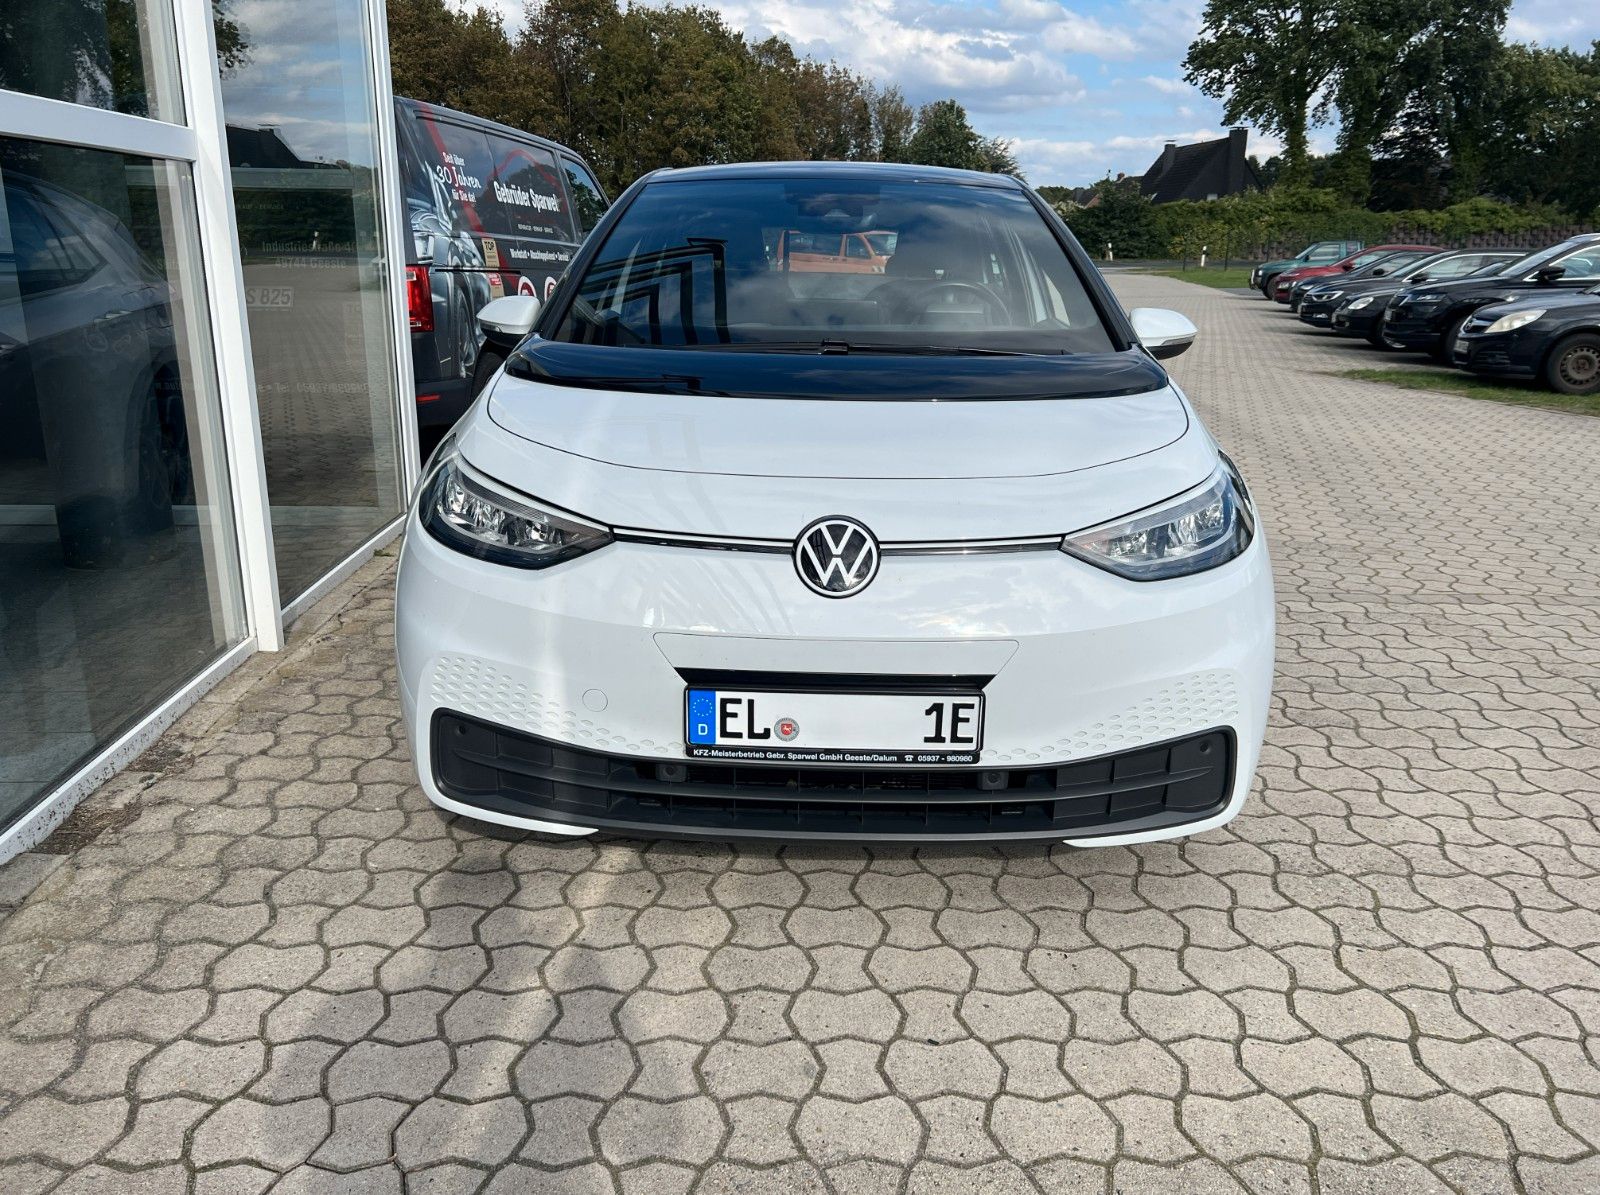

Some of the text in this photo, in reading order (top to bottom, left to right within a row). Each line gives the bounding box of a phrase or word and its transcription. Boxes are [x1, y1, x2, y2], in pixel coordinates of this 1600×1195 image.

[436, 165, 482, 189] 30 Jahren
[493, 181, 560, 213] Gebrüder Sparwel
[484, 240, 495, 251] TOP
[698, 723, 708, 735] D
[719, 697, 771, 740] EL
[923, 702, 976, 744] 1E
[693, 748, 765, 759] KFZ-Meisterbetrieb
[766, 751, 786, 759] Gebr.
[787, 752, 818, 761] Sparwel
[819, 753, 843, 761] GmbH
[844, 754, 897, 762] Geeste/Dalum
